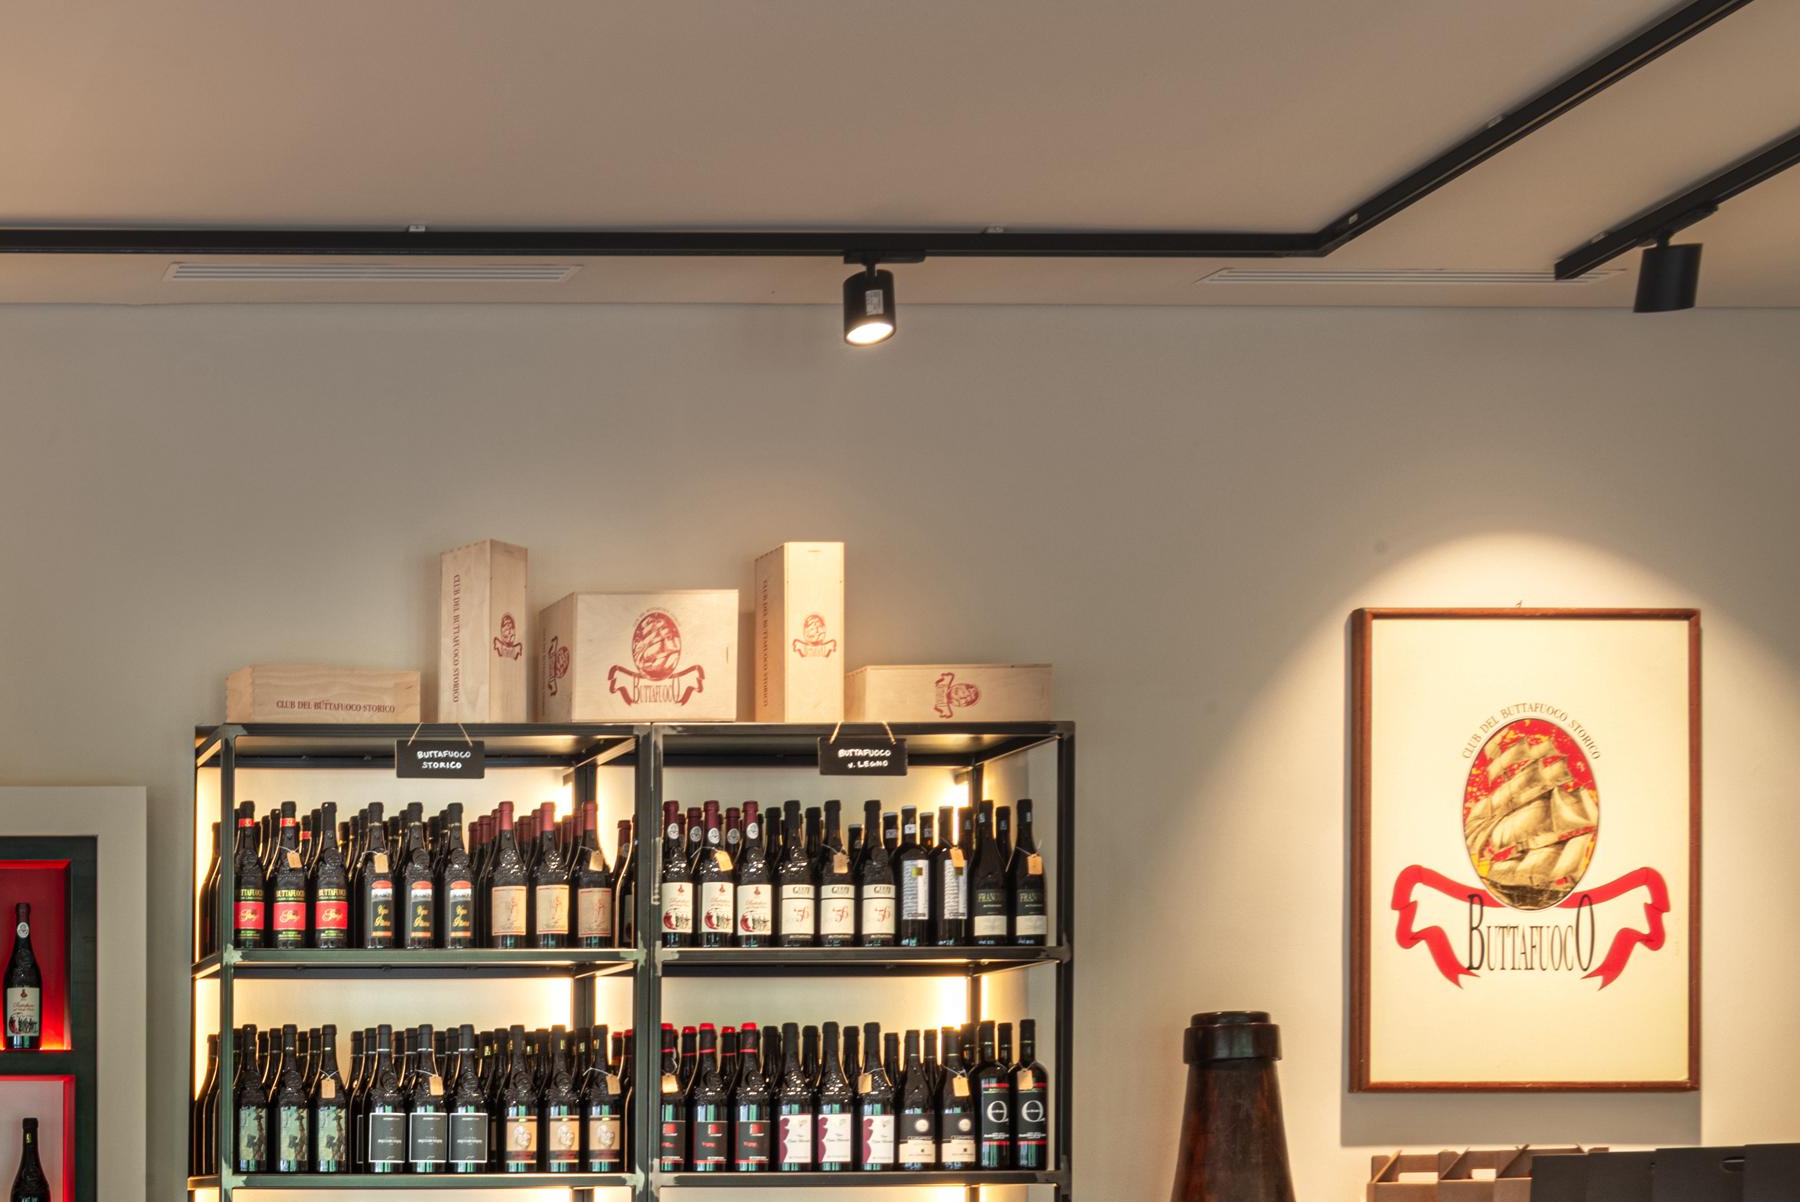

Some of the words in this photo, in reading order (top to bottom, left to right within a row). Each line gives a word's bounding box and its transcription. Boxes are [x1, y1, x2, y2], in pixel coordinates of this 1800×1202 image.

[276, 700, 296, 710] CLUB
[298, 701, 313, 710] DEL
[314, 702, 362, 712] BUTTAFUOCO
[363, 704, 395, 713] STORICO
[1462, 733, 1481, 759] CLUB
[1479, 716, 1500, 733] DEL
[1500, 702, 1568, 721] BUTTAFUOCO
[1568, 720, 1601, 760] STORICO
[417, 751, 471, 759] BUTTAFUOCO
[838, 749, 891, 758] BUTTAFUOCO
[422, 761, 462, 769] STORICO
[857, 760, 889, 768] LEGNO
[1467, 894, 1595, 973] BUTTAFUOCO
